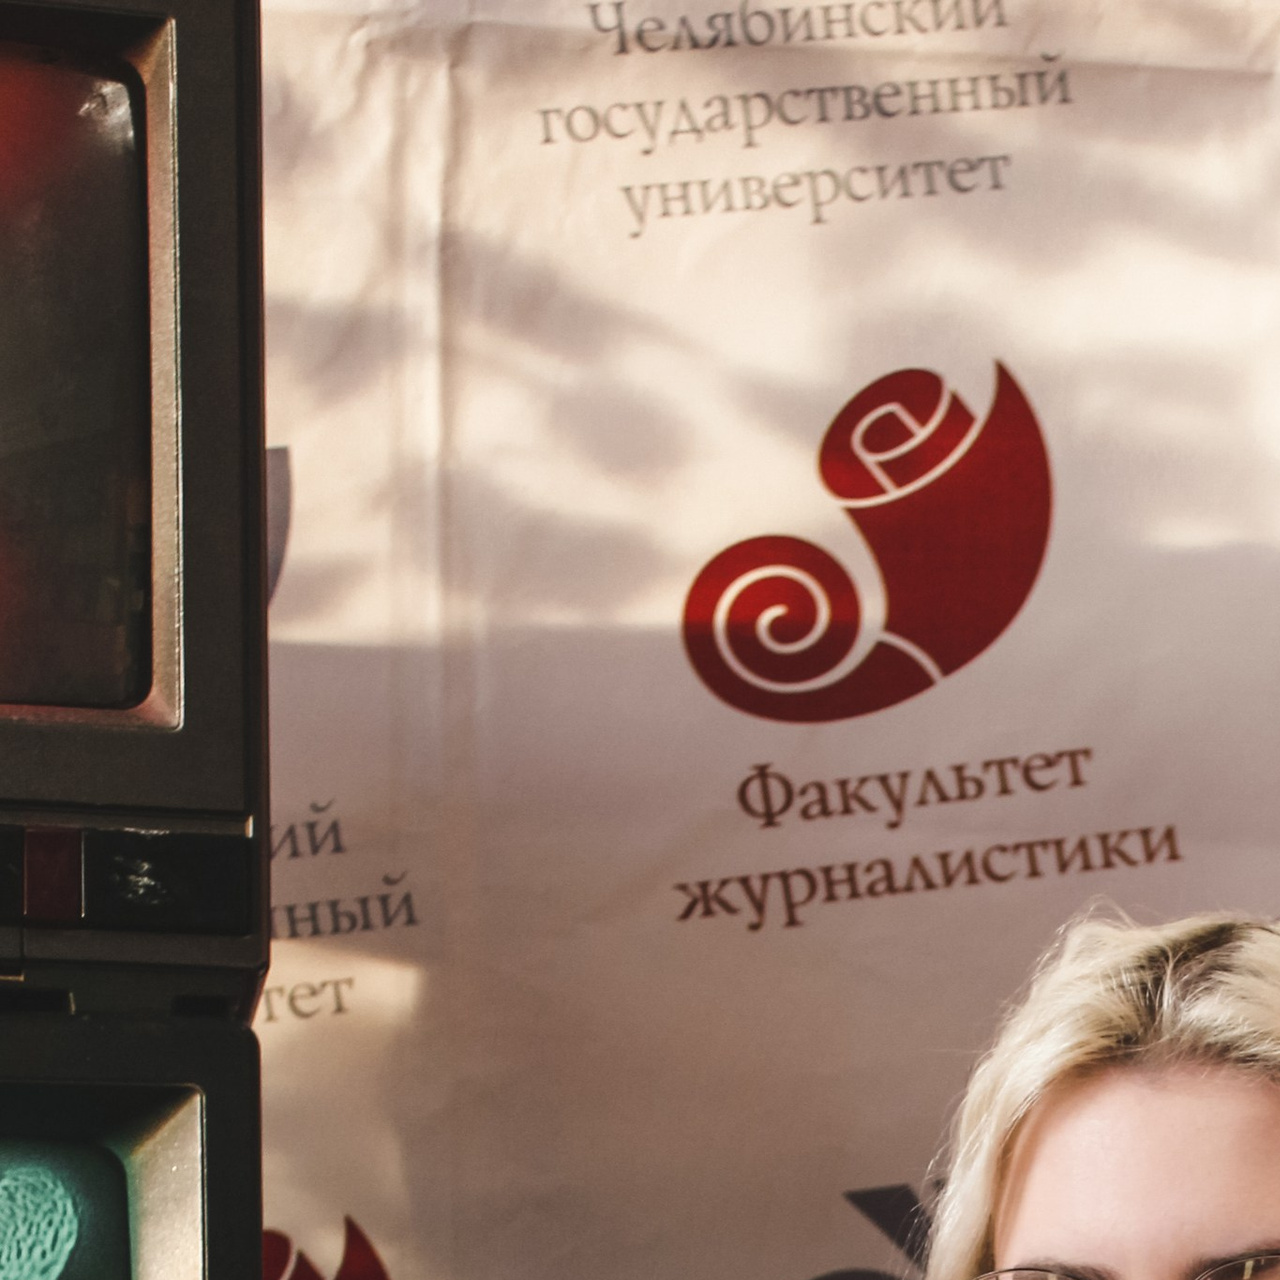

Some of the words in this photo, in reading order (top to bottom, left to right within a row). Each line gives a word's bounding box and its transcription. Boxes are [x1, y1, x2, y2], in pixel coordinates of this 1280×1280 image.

[538, 53, 1074, 154] государственный
[620, 152, 1012, 239] университет
[736, 747, 1093, 830] Факультет
[673, 823, 1184, 931] журналистики
